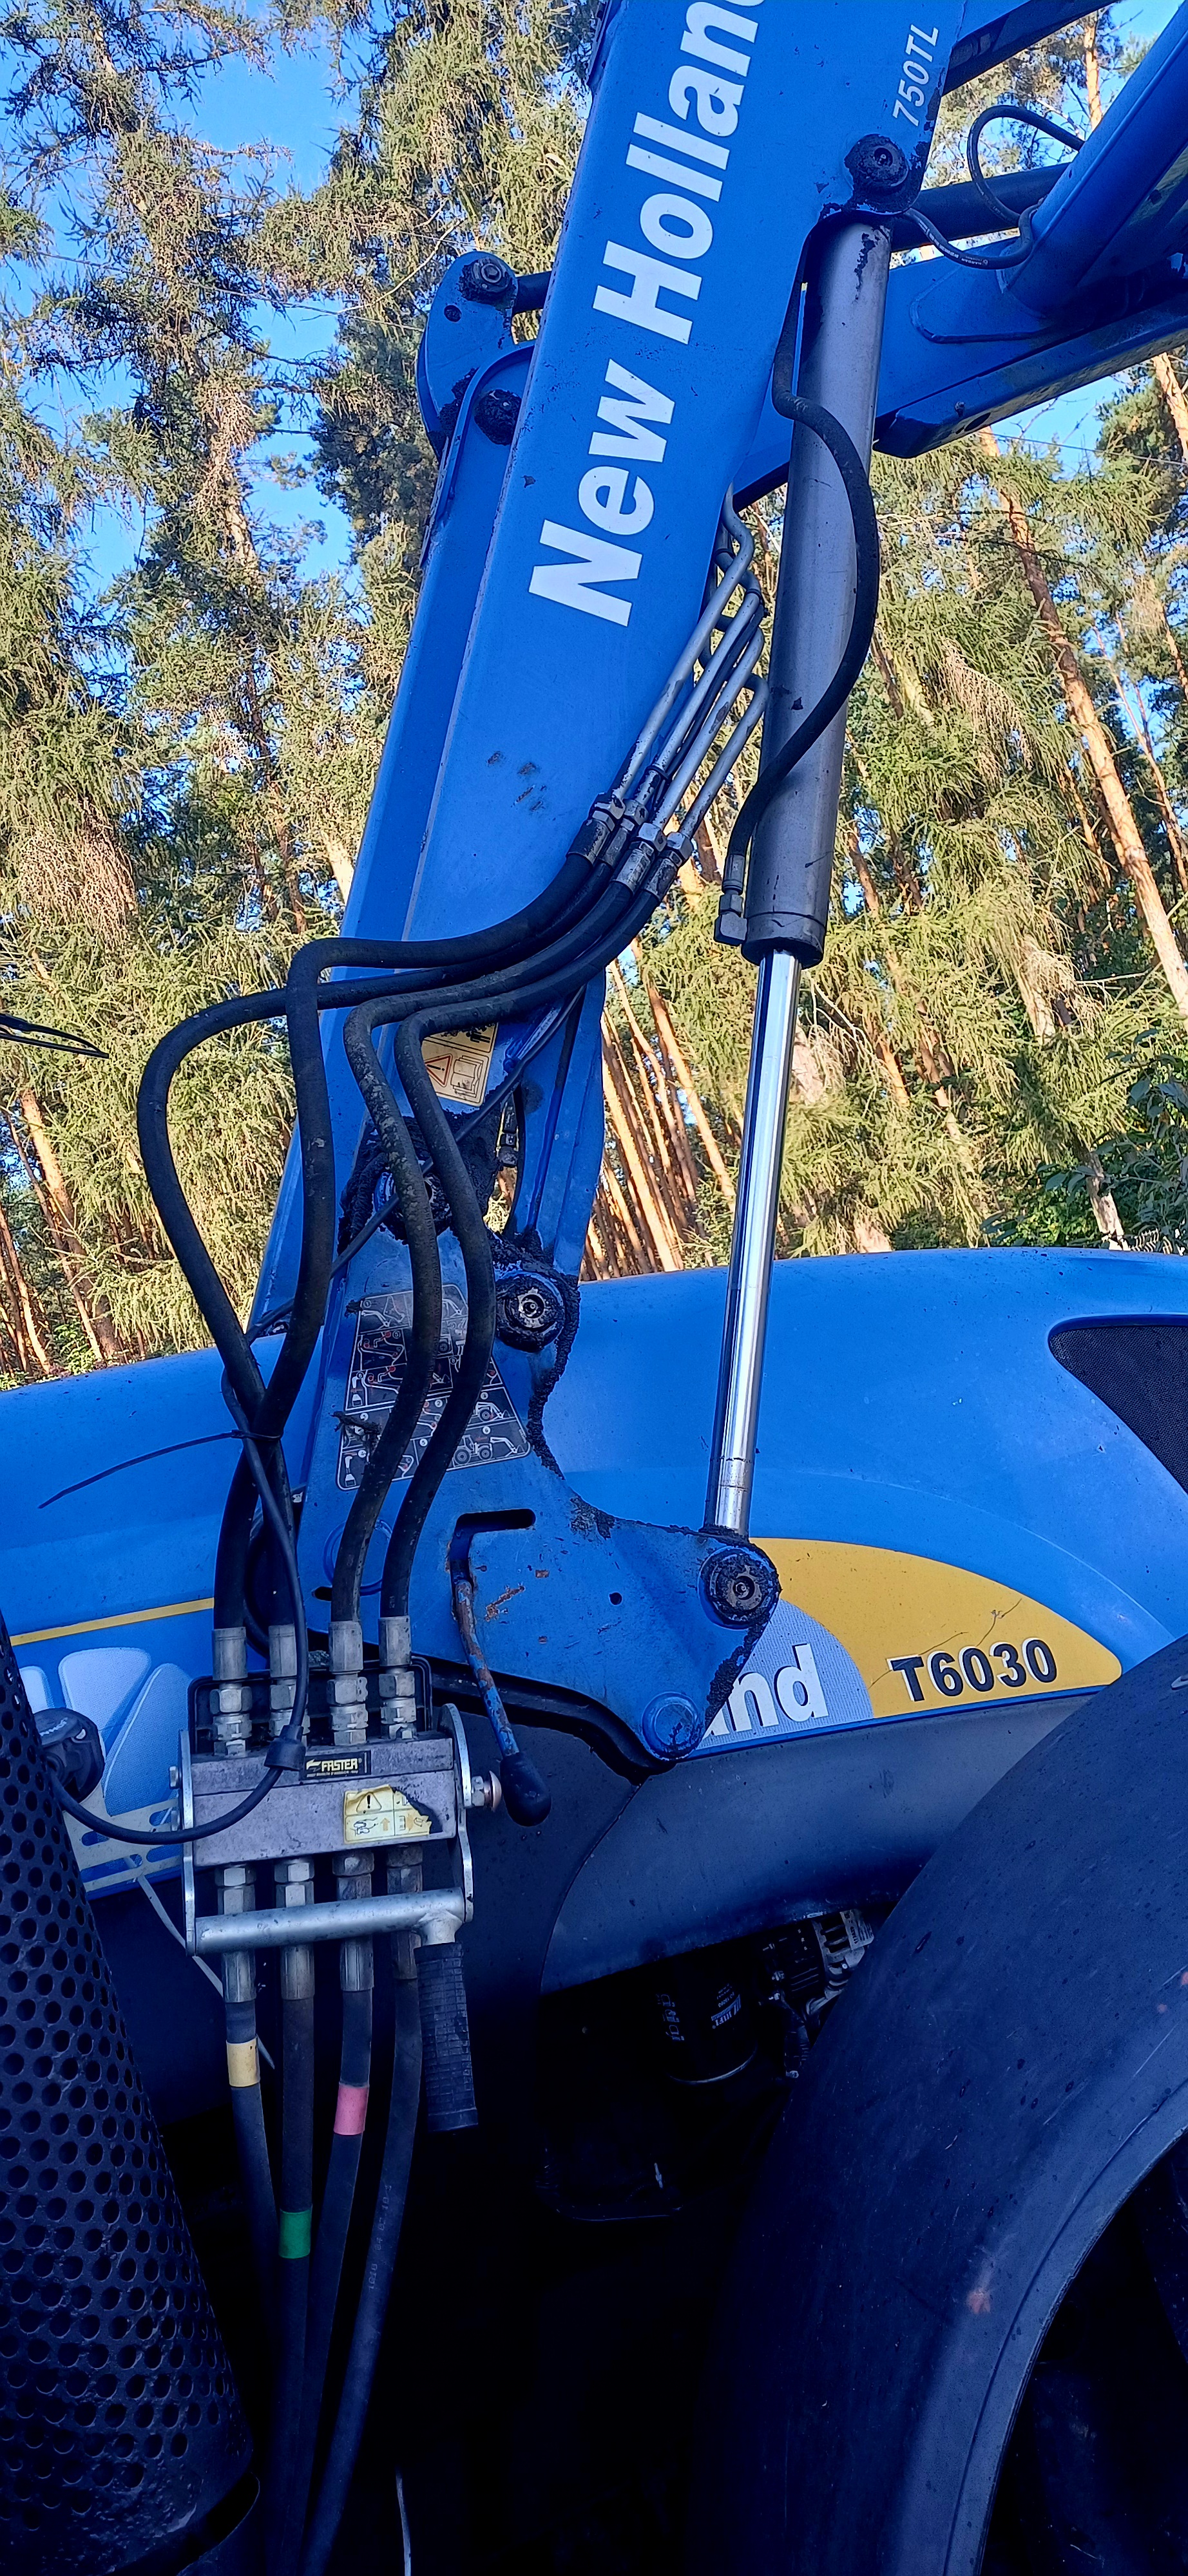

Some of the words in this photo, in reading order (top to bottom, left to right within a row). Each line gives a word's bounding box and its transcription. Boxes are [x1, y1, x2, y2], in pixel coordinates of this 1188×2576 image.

[892, 24, 940, 128] 750TL
[592, 0, 765, 346] Hollan
[528, 359, 676, 628] New
[702, 1643, 829, 1739] nd
[887, 1638, 1058, 1703] T6030
[321, 1757, 358, 1772] FASTER
